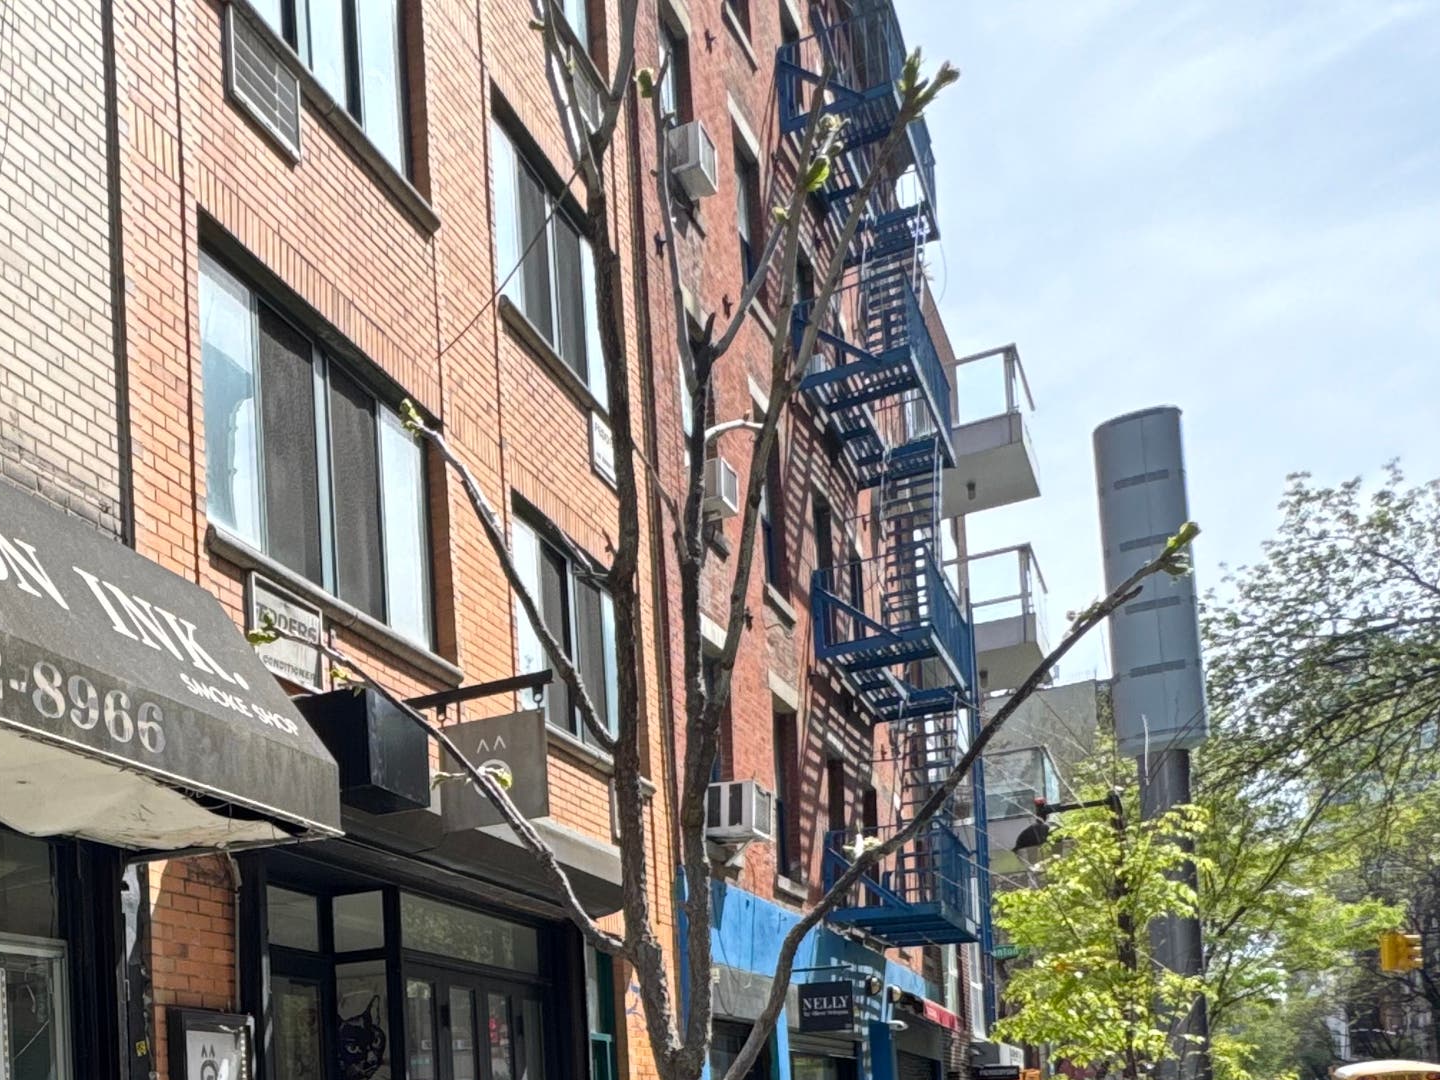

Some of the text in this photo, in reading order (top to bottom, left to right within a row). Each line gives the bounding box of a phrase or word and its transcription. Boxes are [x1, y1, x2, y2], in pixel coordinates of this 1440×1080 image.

[72, 566, 249, 690] INK.
[180, 673, 299, 736] SMOKE SHOP
[802, 995, 849, 1010] NELLY
